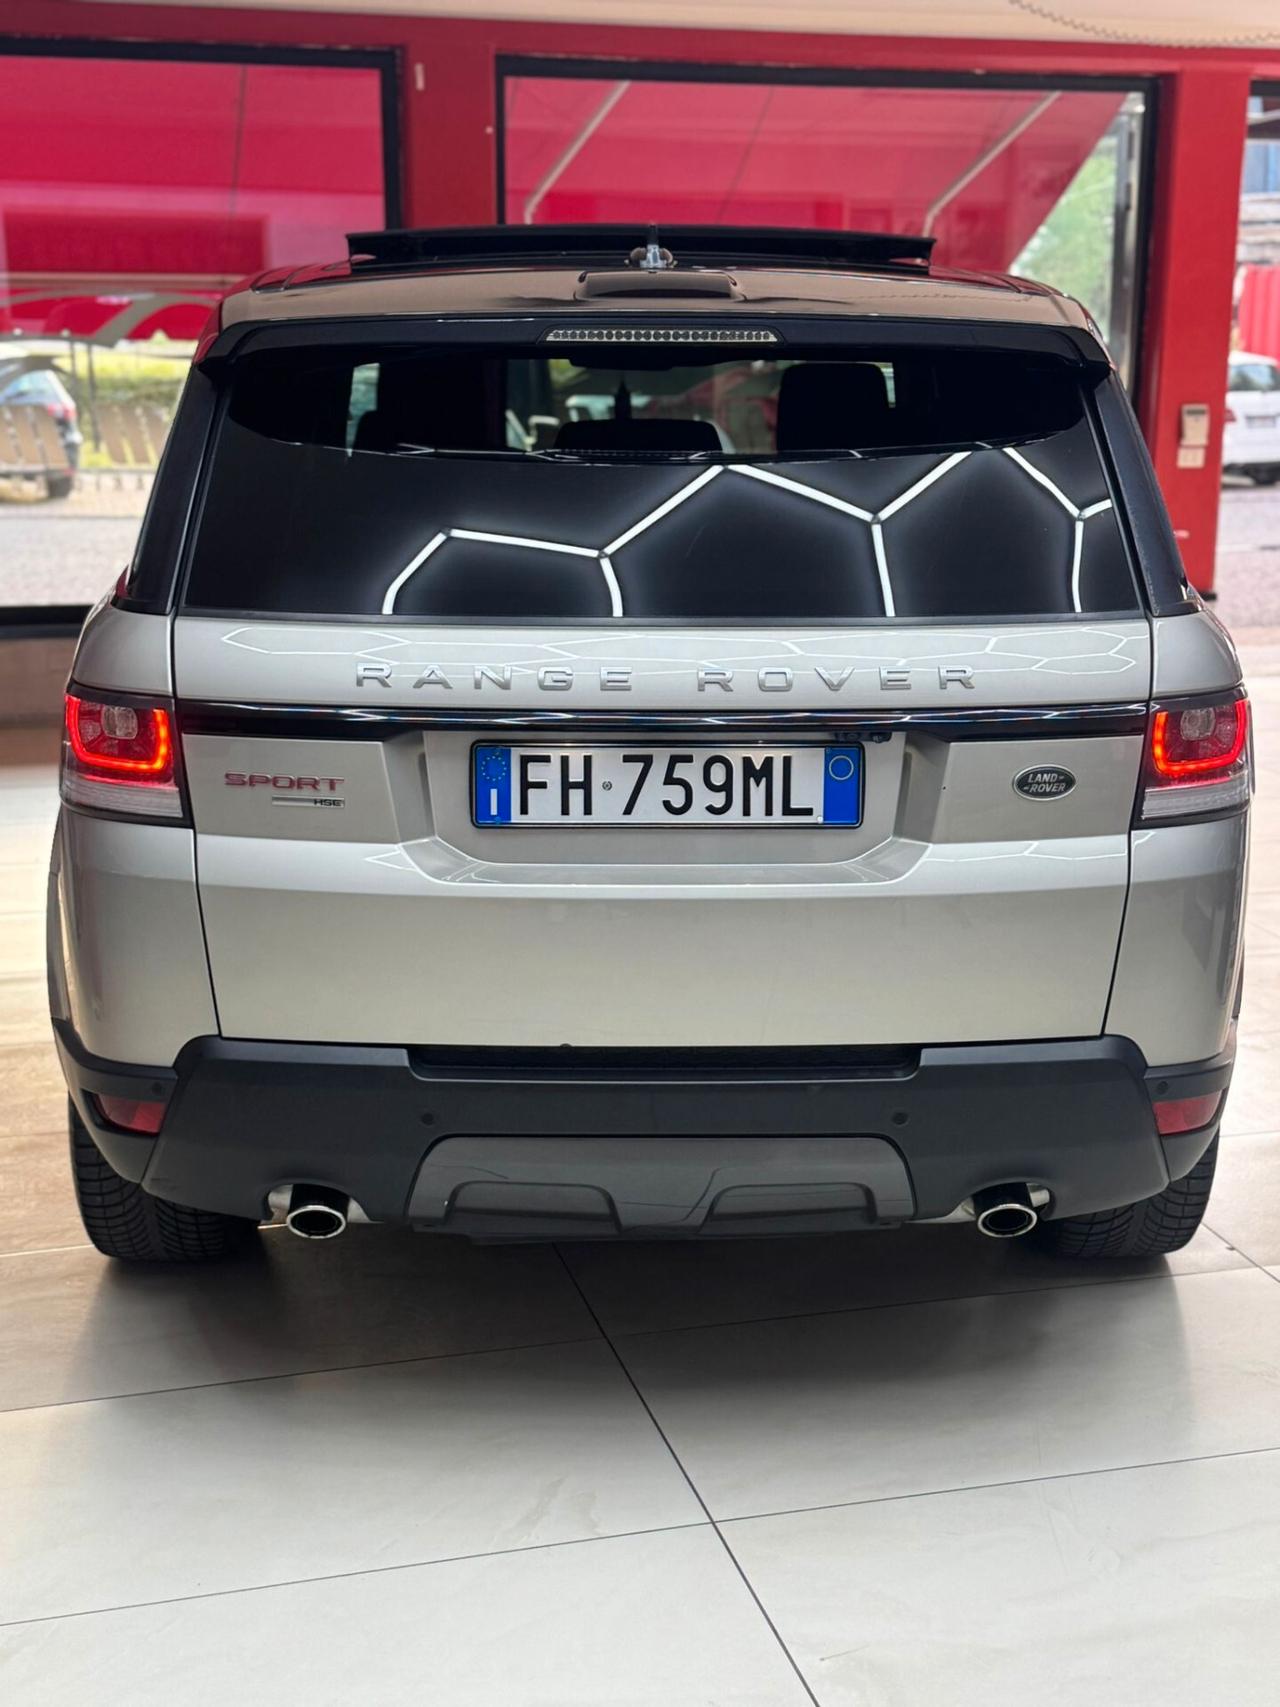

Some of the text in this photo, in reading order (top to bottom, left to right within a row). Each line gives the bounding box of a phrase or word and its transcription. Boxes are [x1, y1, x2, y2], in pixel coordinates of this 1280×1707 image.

[356, 663, 975, 692] RANGE ROVER
[224, 771, 345, 791] SPORT
[519, 754, 814, 817] FH 759ML
[313, 799, 342, 807] HSE
